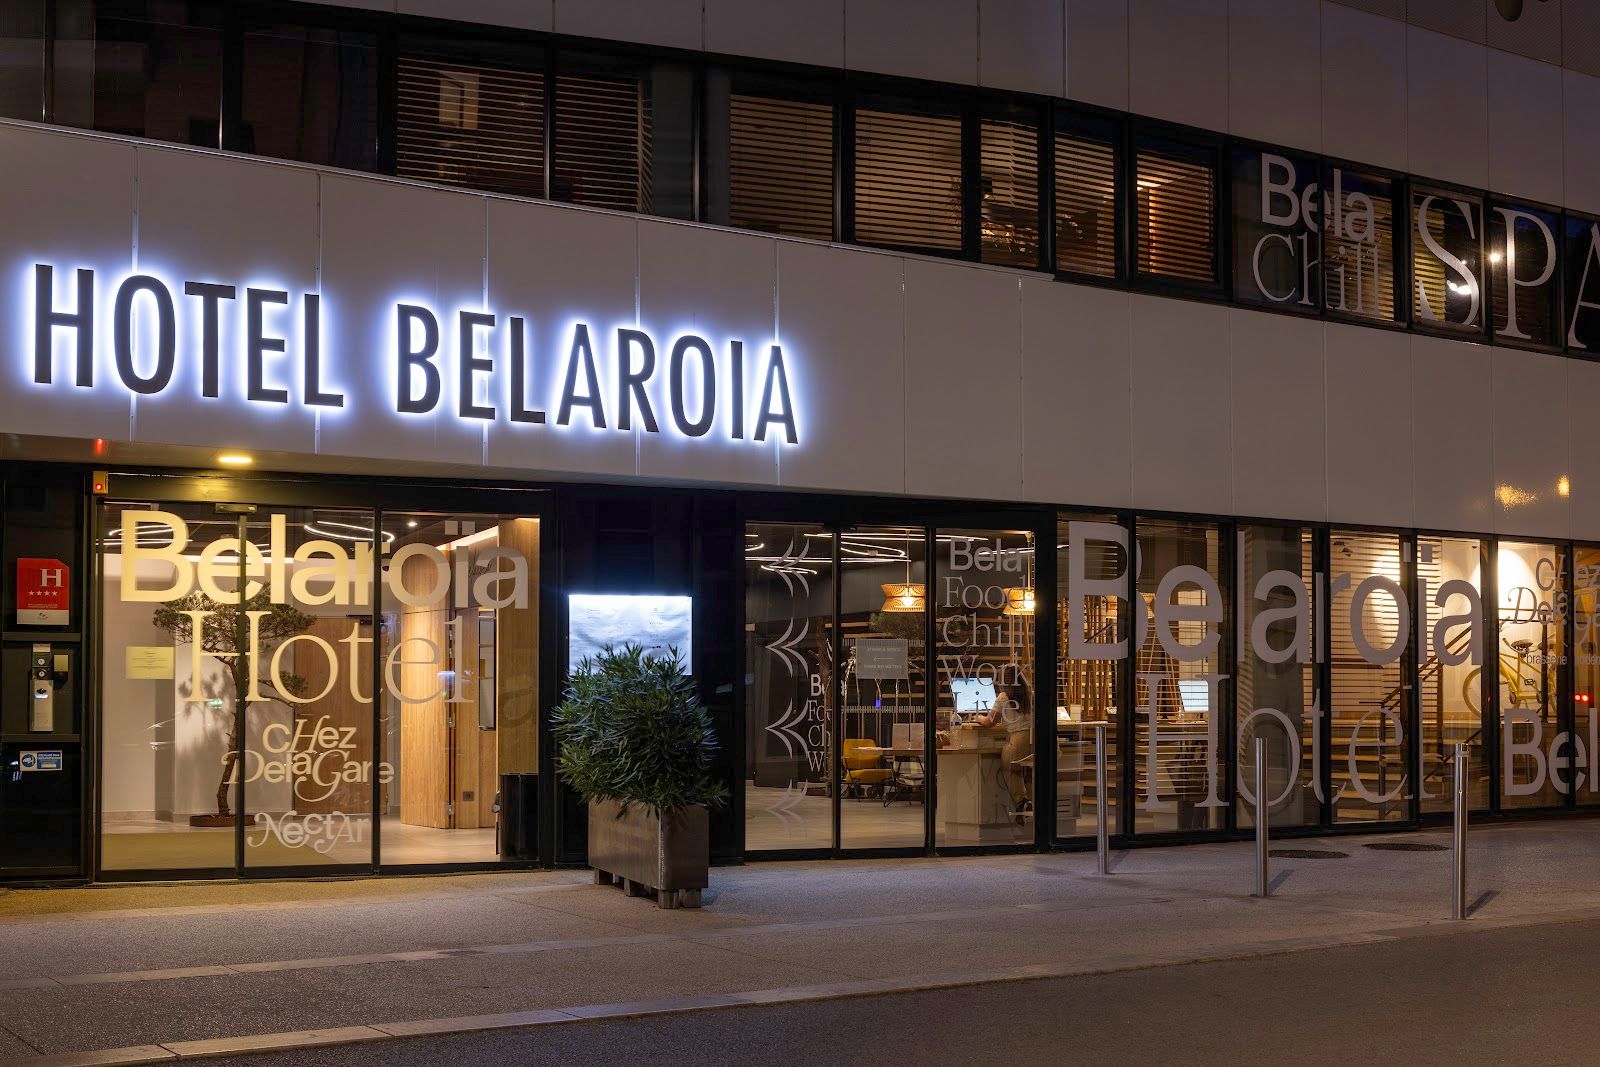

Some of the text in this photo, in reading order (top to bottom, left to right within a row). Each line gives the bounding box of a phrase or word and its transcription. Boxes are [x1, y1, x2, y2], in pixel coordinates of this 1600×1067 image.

[1261, 152, 1375, 242] Bela
[1252, 230, 1381, 317] Chill
[34, 264, 798, 444] HOTEL BELAROIA
[40, 568, 64, 587] H
[950, 538, 1022, 572] Bela
[943, 574, 1027, 610] Food
[180, 610, 475, 705] Hotel
[943, 611, 1023, 649] Chill
[943, 650, 1031, 687] Work
[952, 691, 1020, 724] Live
[1137, 672, 1436, 811] Hotel
[1504, 707, 1599, 796] Bel
